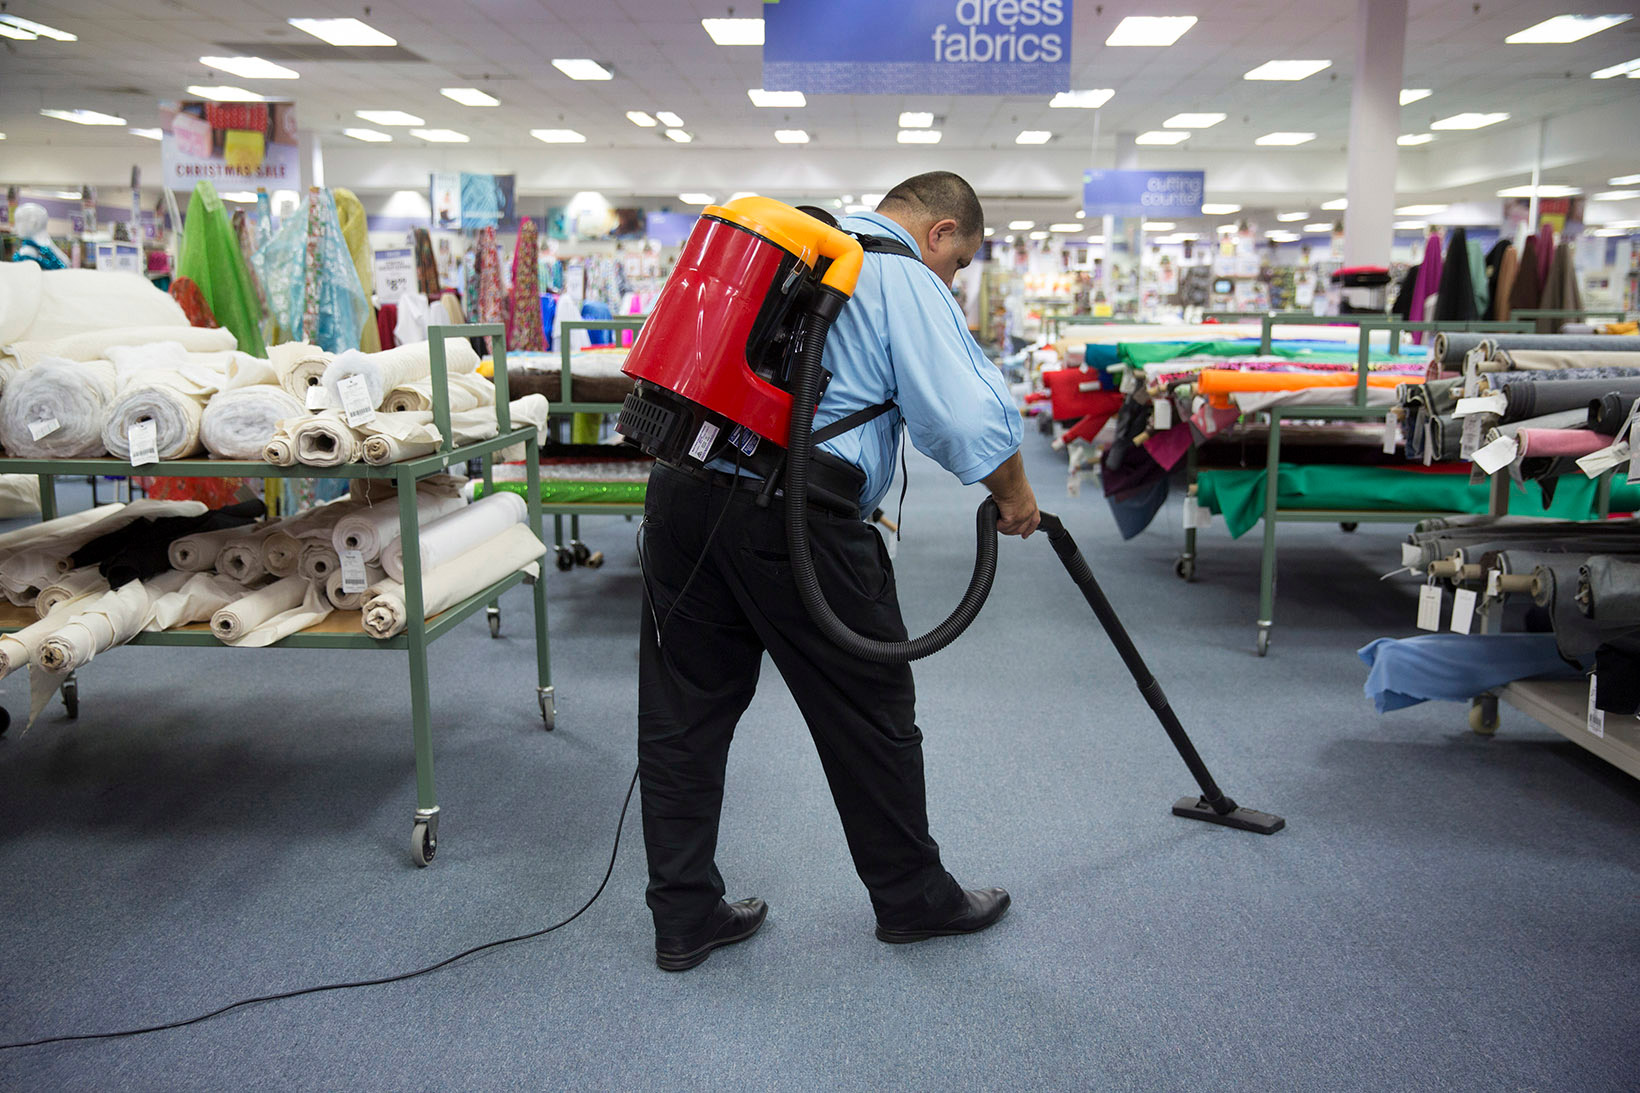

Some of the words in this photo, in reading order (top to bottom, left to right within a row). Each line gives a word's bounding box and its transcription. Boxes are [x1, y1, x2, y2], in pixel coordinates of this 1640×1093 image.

[956, 0, 1063, 26] dress
[932, 25, 1063, 62] fabrics
[176, 165, 251, 177] CHRISTMAS
[256, 165, 287, 178] SALE
